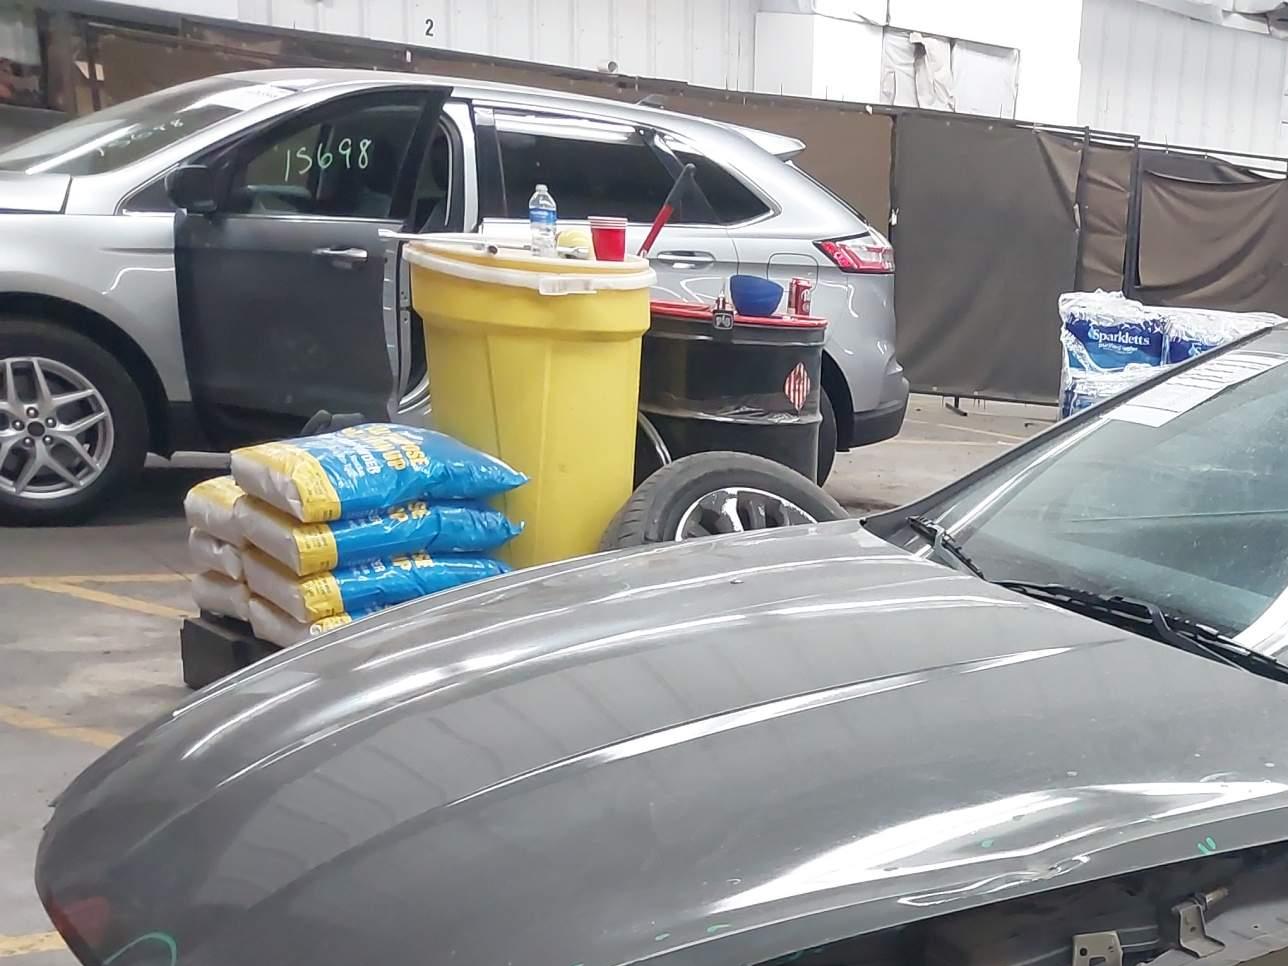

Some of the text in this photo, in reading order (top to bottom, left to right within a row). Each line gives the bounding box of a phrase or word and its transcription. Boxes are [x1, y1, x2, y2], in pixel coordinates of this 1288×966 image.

[425, 18, 434, 37] 2
[283, 138, 372, 182] 15698
[1093, 328, 1150, 346] Sparkletts
